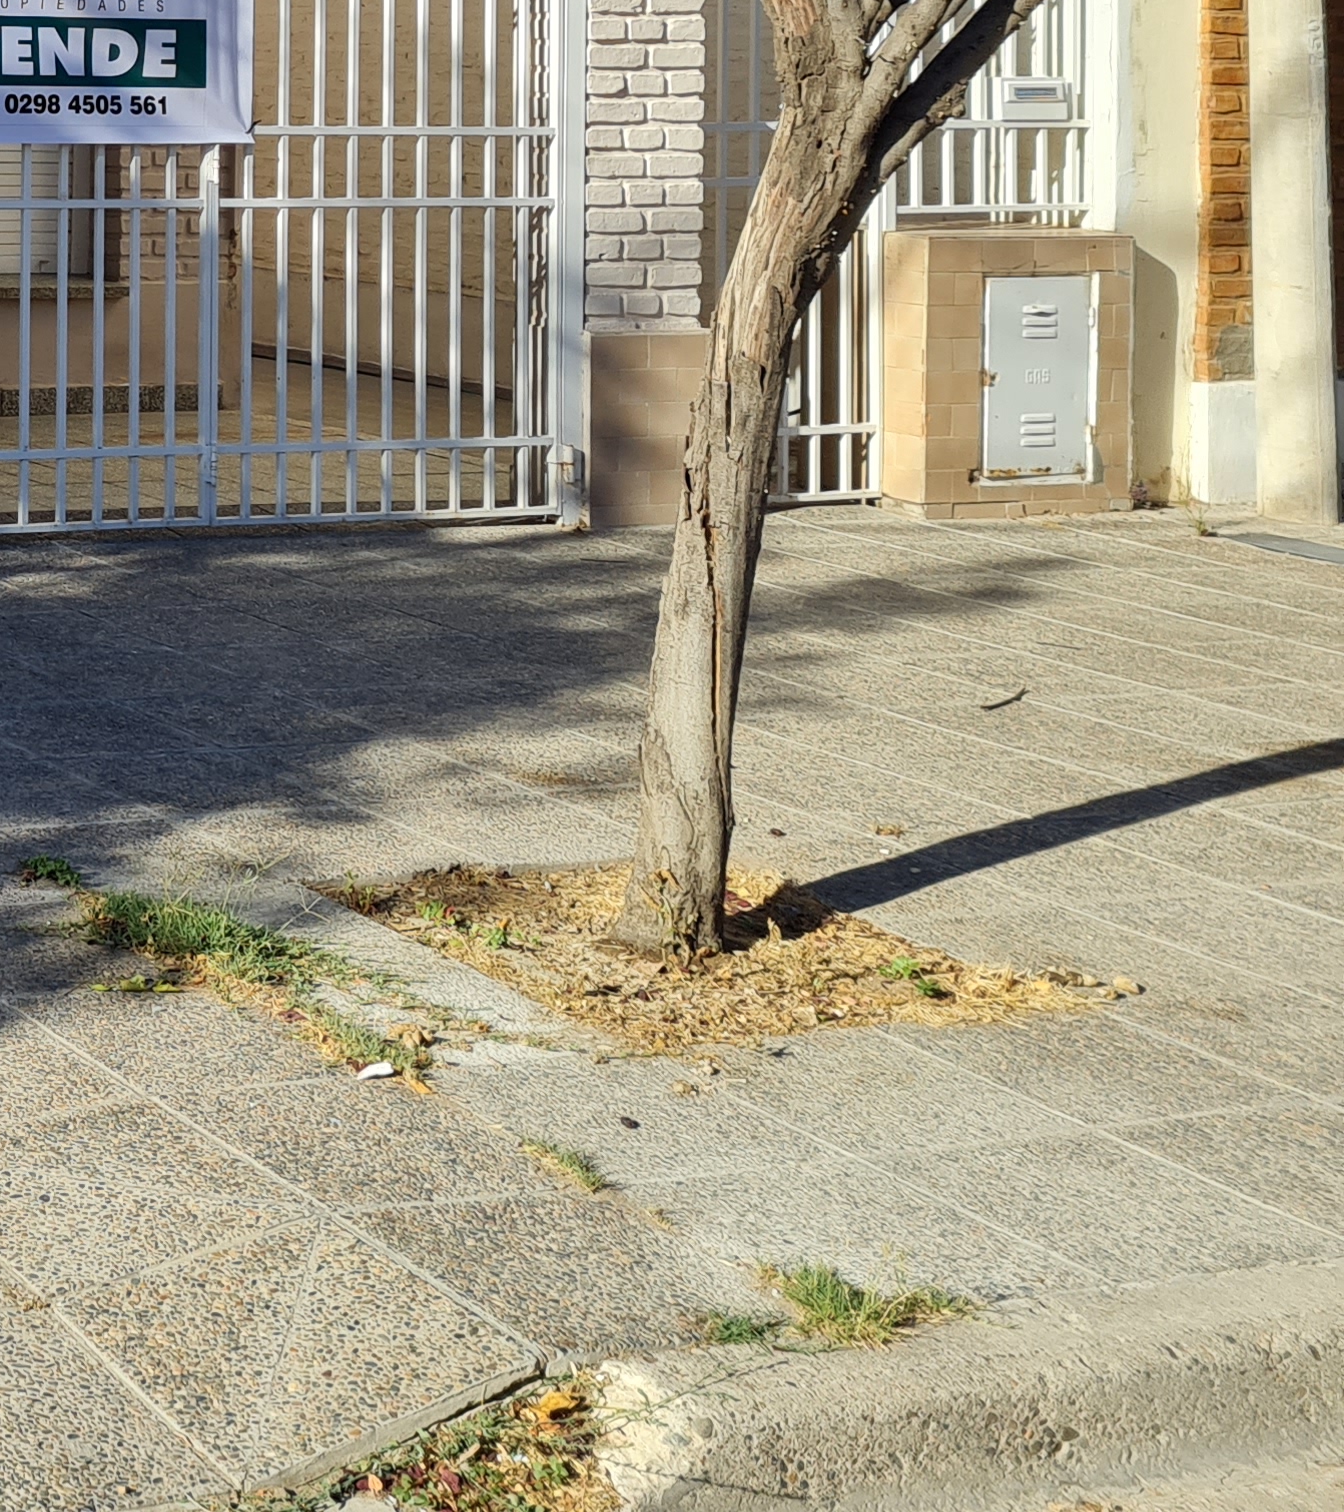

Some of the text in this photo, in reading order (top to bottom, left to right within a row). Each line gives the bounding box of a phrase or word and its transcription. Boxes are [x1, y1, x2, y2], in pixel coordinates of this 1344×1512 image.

[4, 94, 61, 114] 0298
[67, 95, 123, 115] 4505
[129, 96, 168, 115] 561
[1024, 368, 1051, 384] GAS
